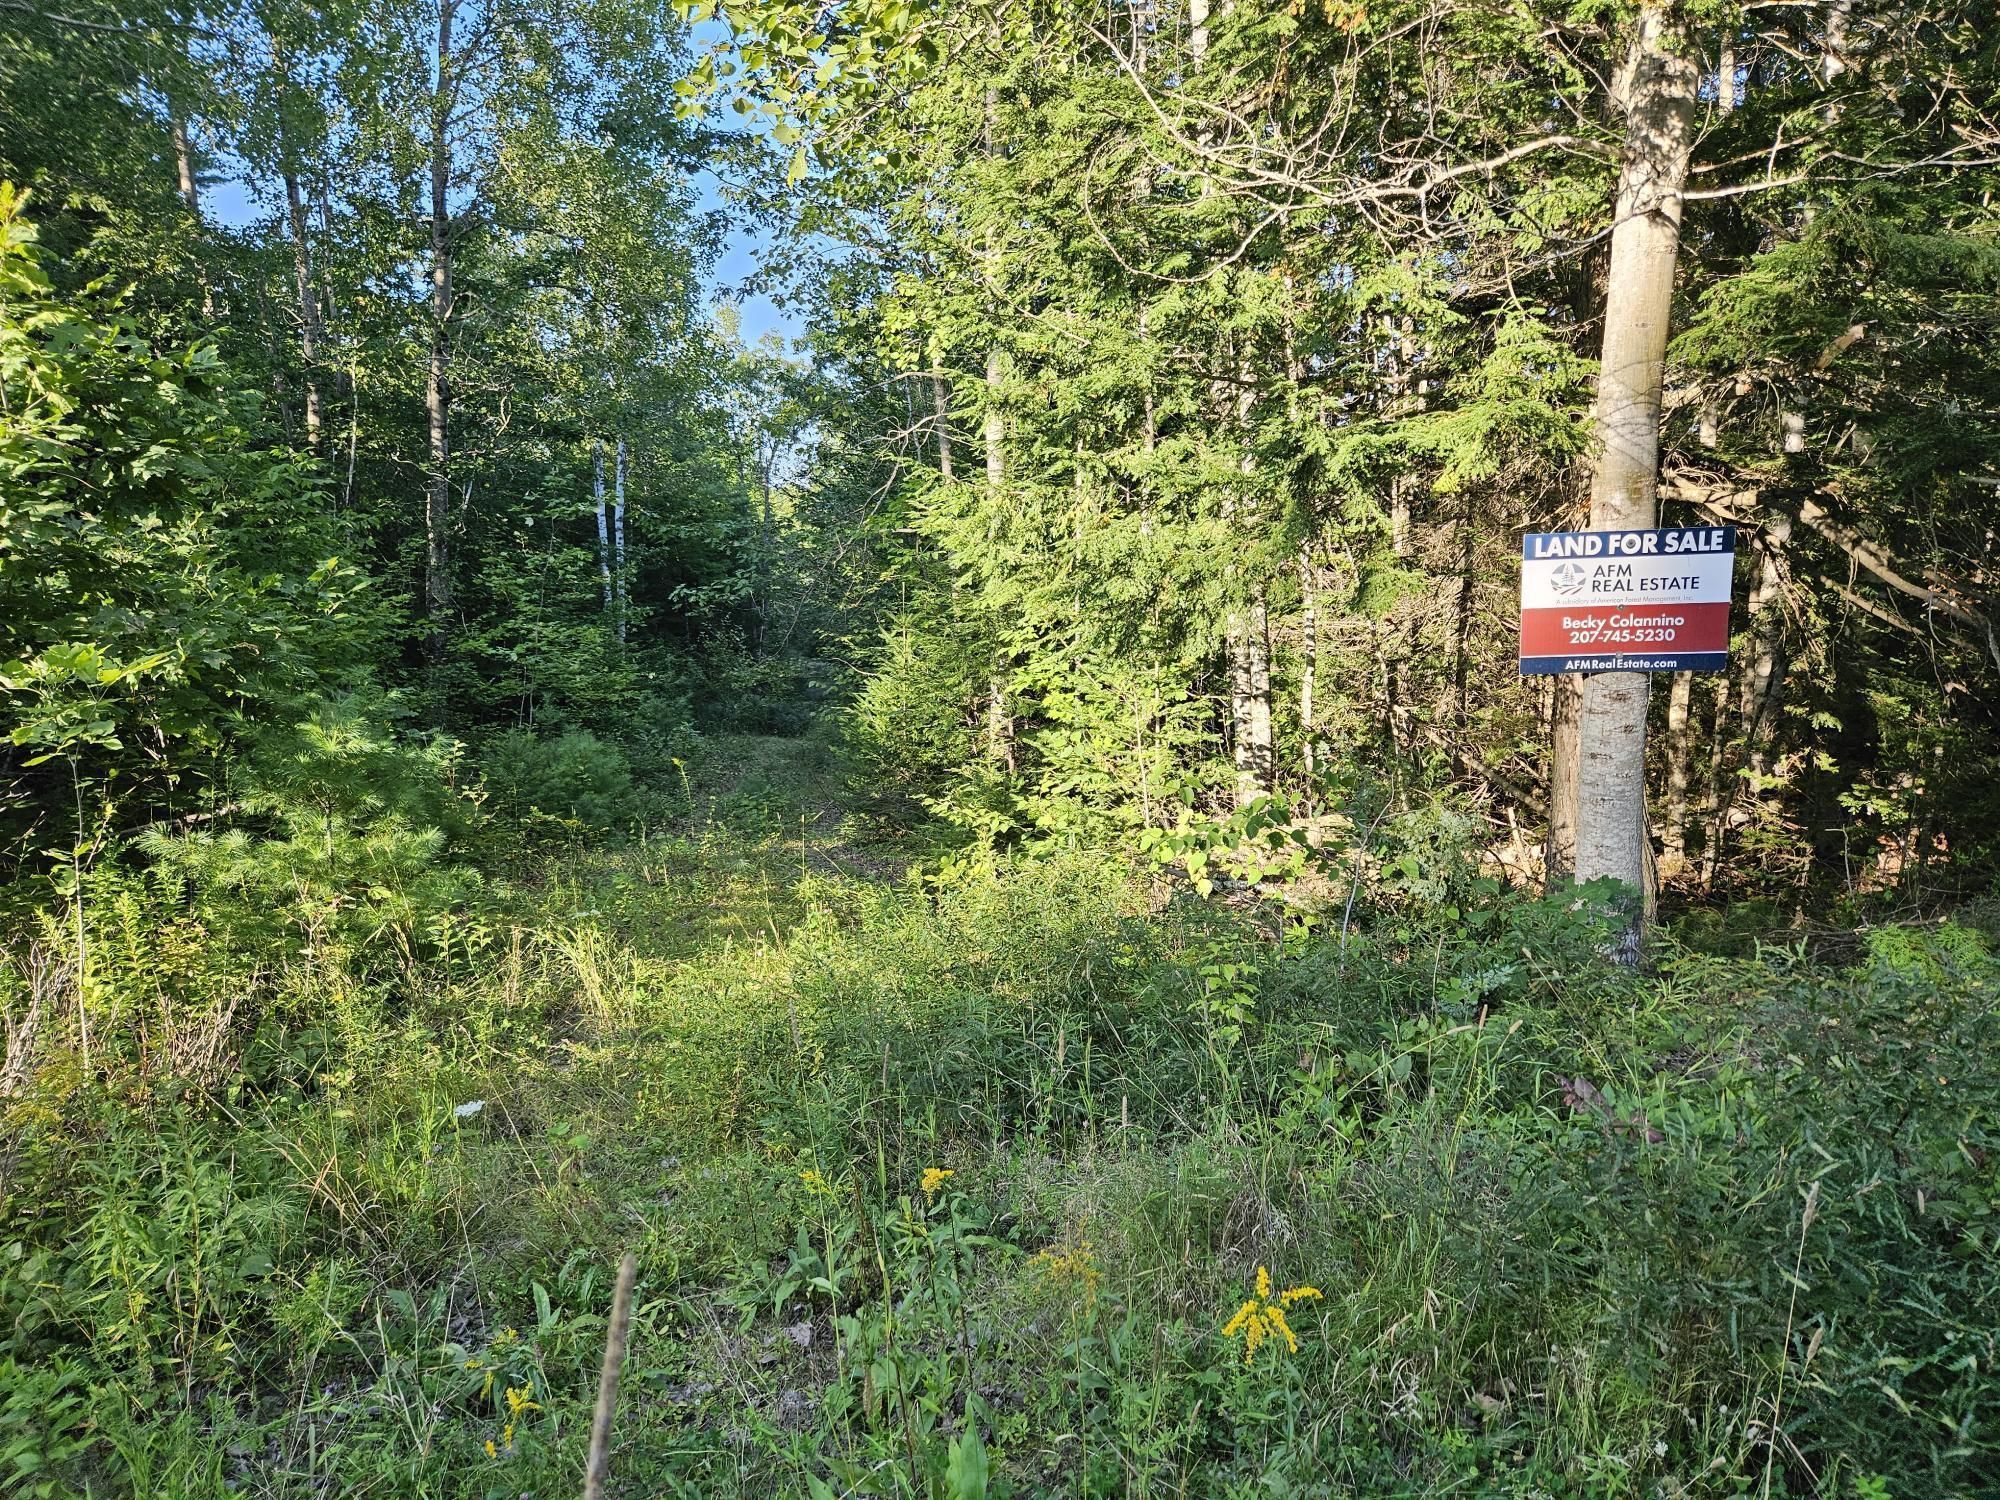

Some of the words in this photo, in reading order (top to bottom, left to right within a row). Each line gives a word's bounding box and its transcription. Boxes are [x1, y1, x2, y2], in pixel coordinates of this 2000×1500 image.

[1534, 534, 1602, 558] LAND
[1609, 532, 1658, 555] FOR
[1664, 530, 1724, 553] SALE
[1593, 564, 1632, 578] AFM
[1592, 578, 1634, 592] REAL
[1640, 576, 1700, 591] ESTATE
[1562, 615, 1606, 631] Becky
[1610, 613, 1685, 628] Colannino
[1569, 628, 1676, 644] 207-745-5230
[1565, 659, 1677, 670] AFMRealEstate.com
